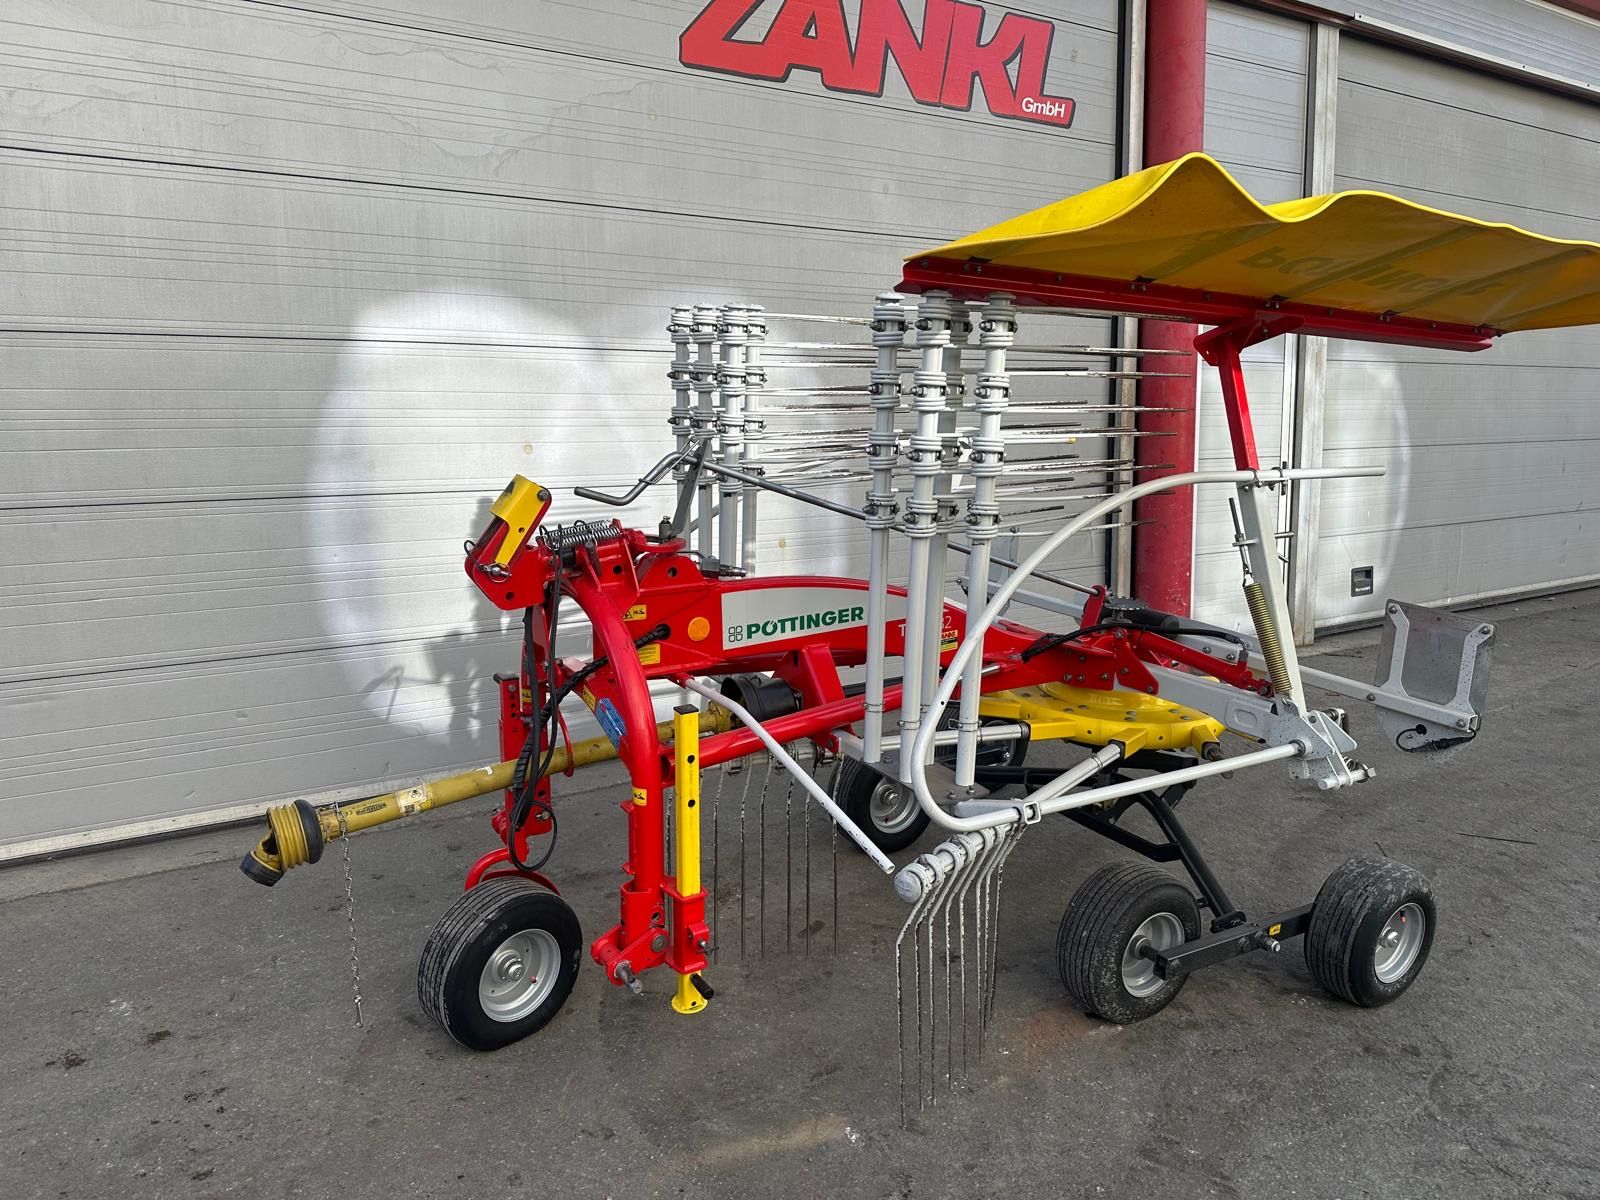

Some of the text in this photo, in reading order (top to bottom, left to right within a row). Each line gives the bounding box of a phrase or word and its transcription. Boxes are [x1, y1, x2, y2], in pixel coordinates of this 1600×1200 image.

[679, 0, 1076, 128] ZANKL
[1021, 97, 1066, 118] GmbH
[746, 606, 864, 640] PÖTTINGER
